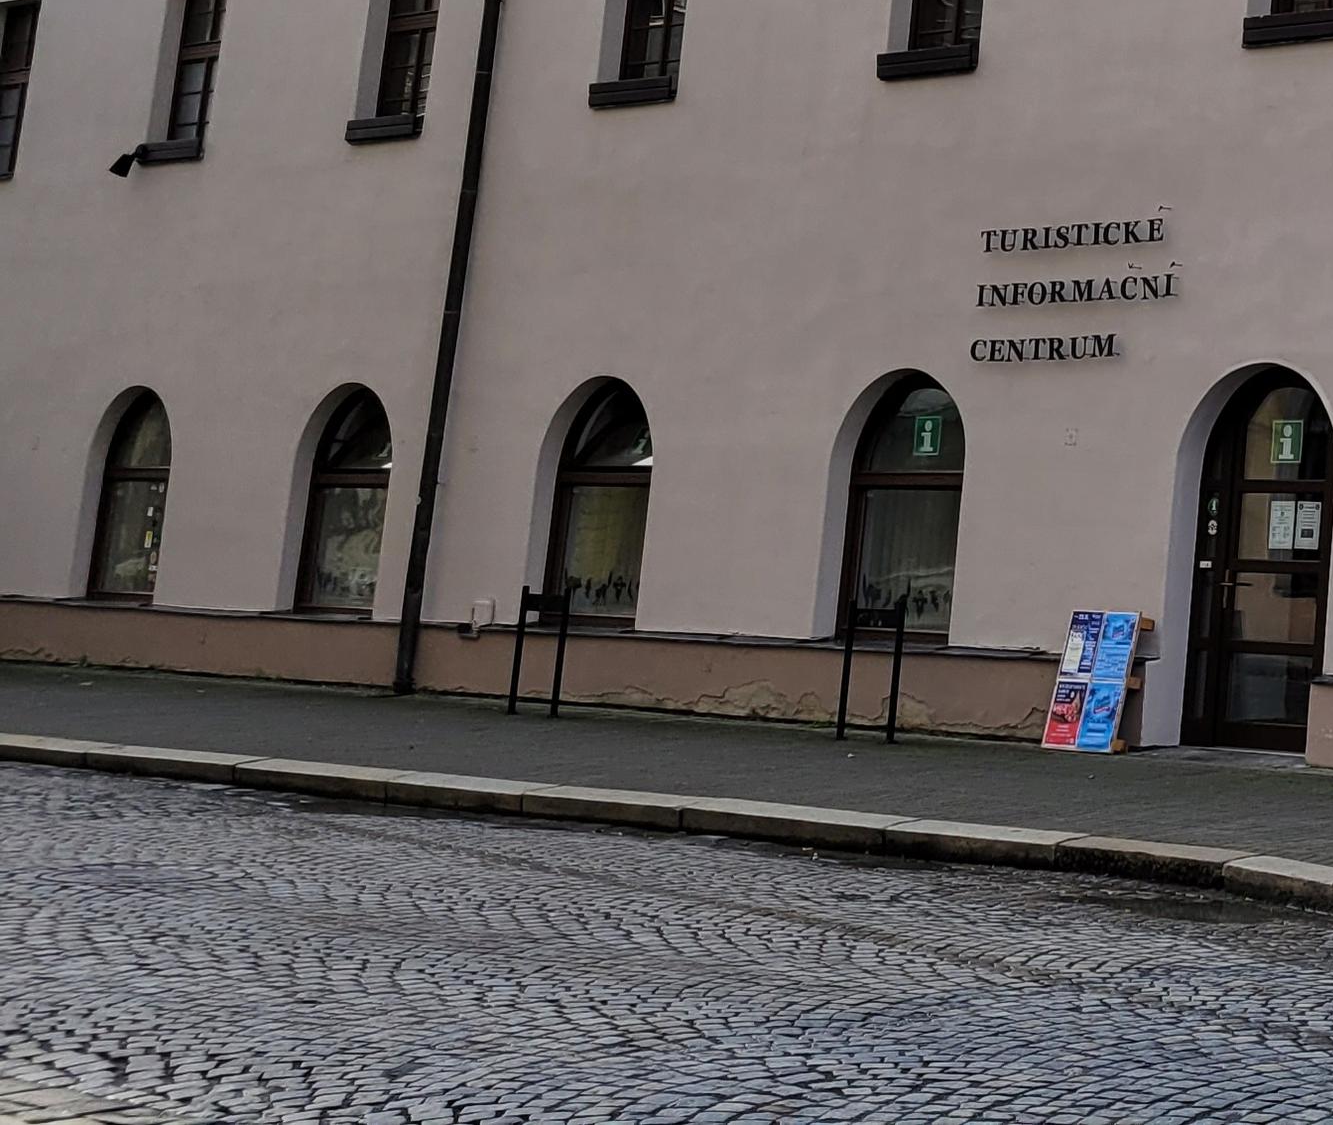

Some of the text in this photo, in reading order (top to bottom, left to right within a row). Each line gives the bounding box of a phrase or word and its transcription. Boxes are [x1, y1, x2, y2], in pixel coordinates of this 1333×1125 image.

[980, 205, 1172, 253] TURISTICKÉ
[975, 261, 1183, 307] INFORMAČNÍ
[969, 333, 1118, 362] CENTRUM
